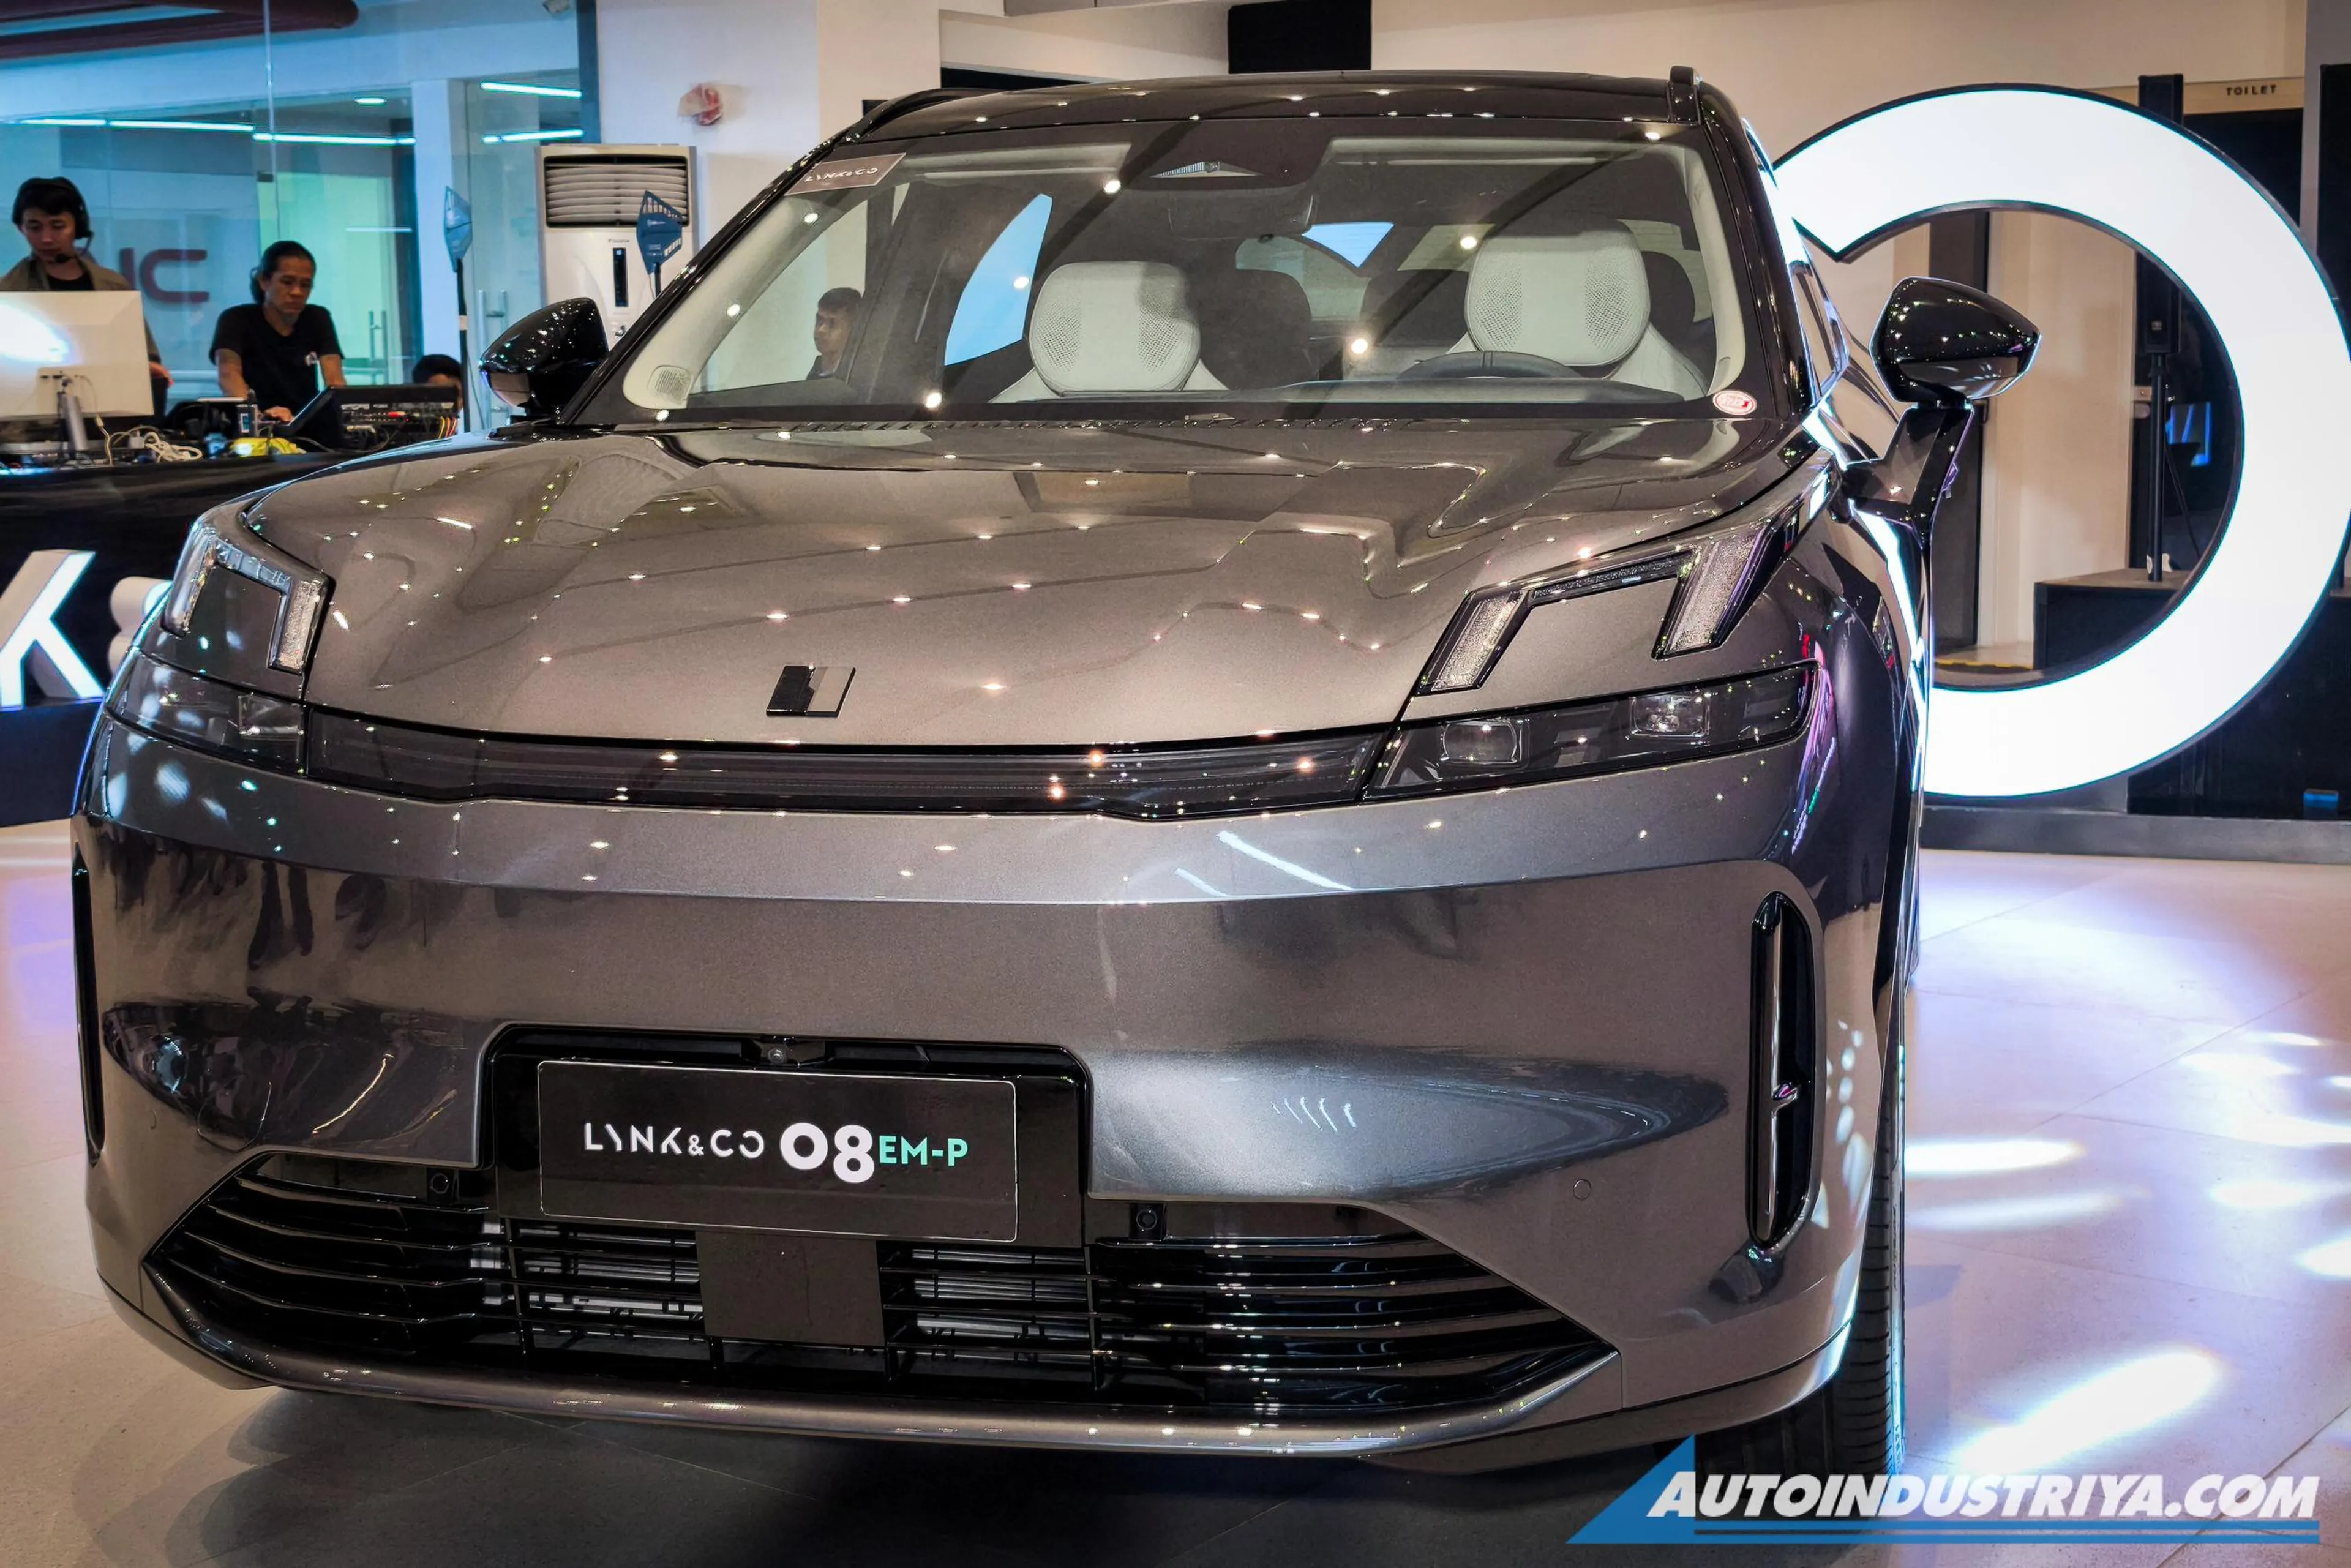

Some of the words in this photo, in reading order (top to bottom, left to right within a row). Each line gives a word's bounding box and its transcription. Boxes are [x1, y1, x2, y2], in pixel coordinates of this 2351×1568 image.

[2227, 84, 2277, 96] TOILET
[584, 1122, 765, 1158] LYNK&CO
[779, 1122, 875, 1184] 08
[879, 1135, 968, 1166] EM-P
